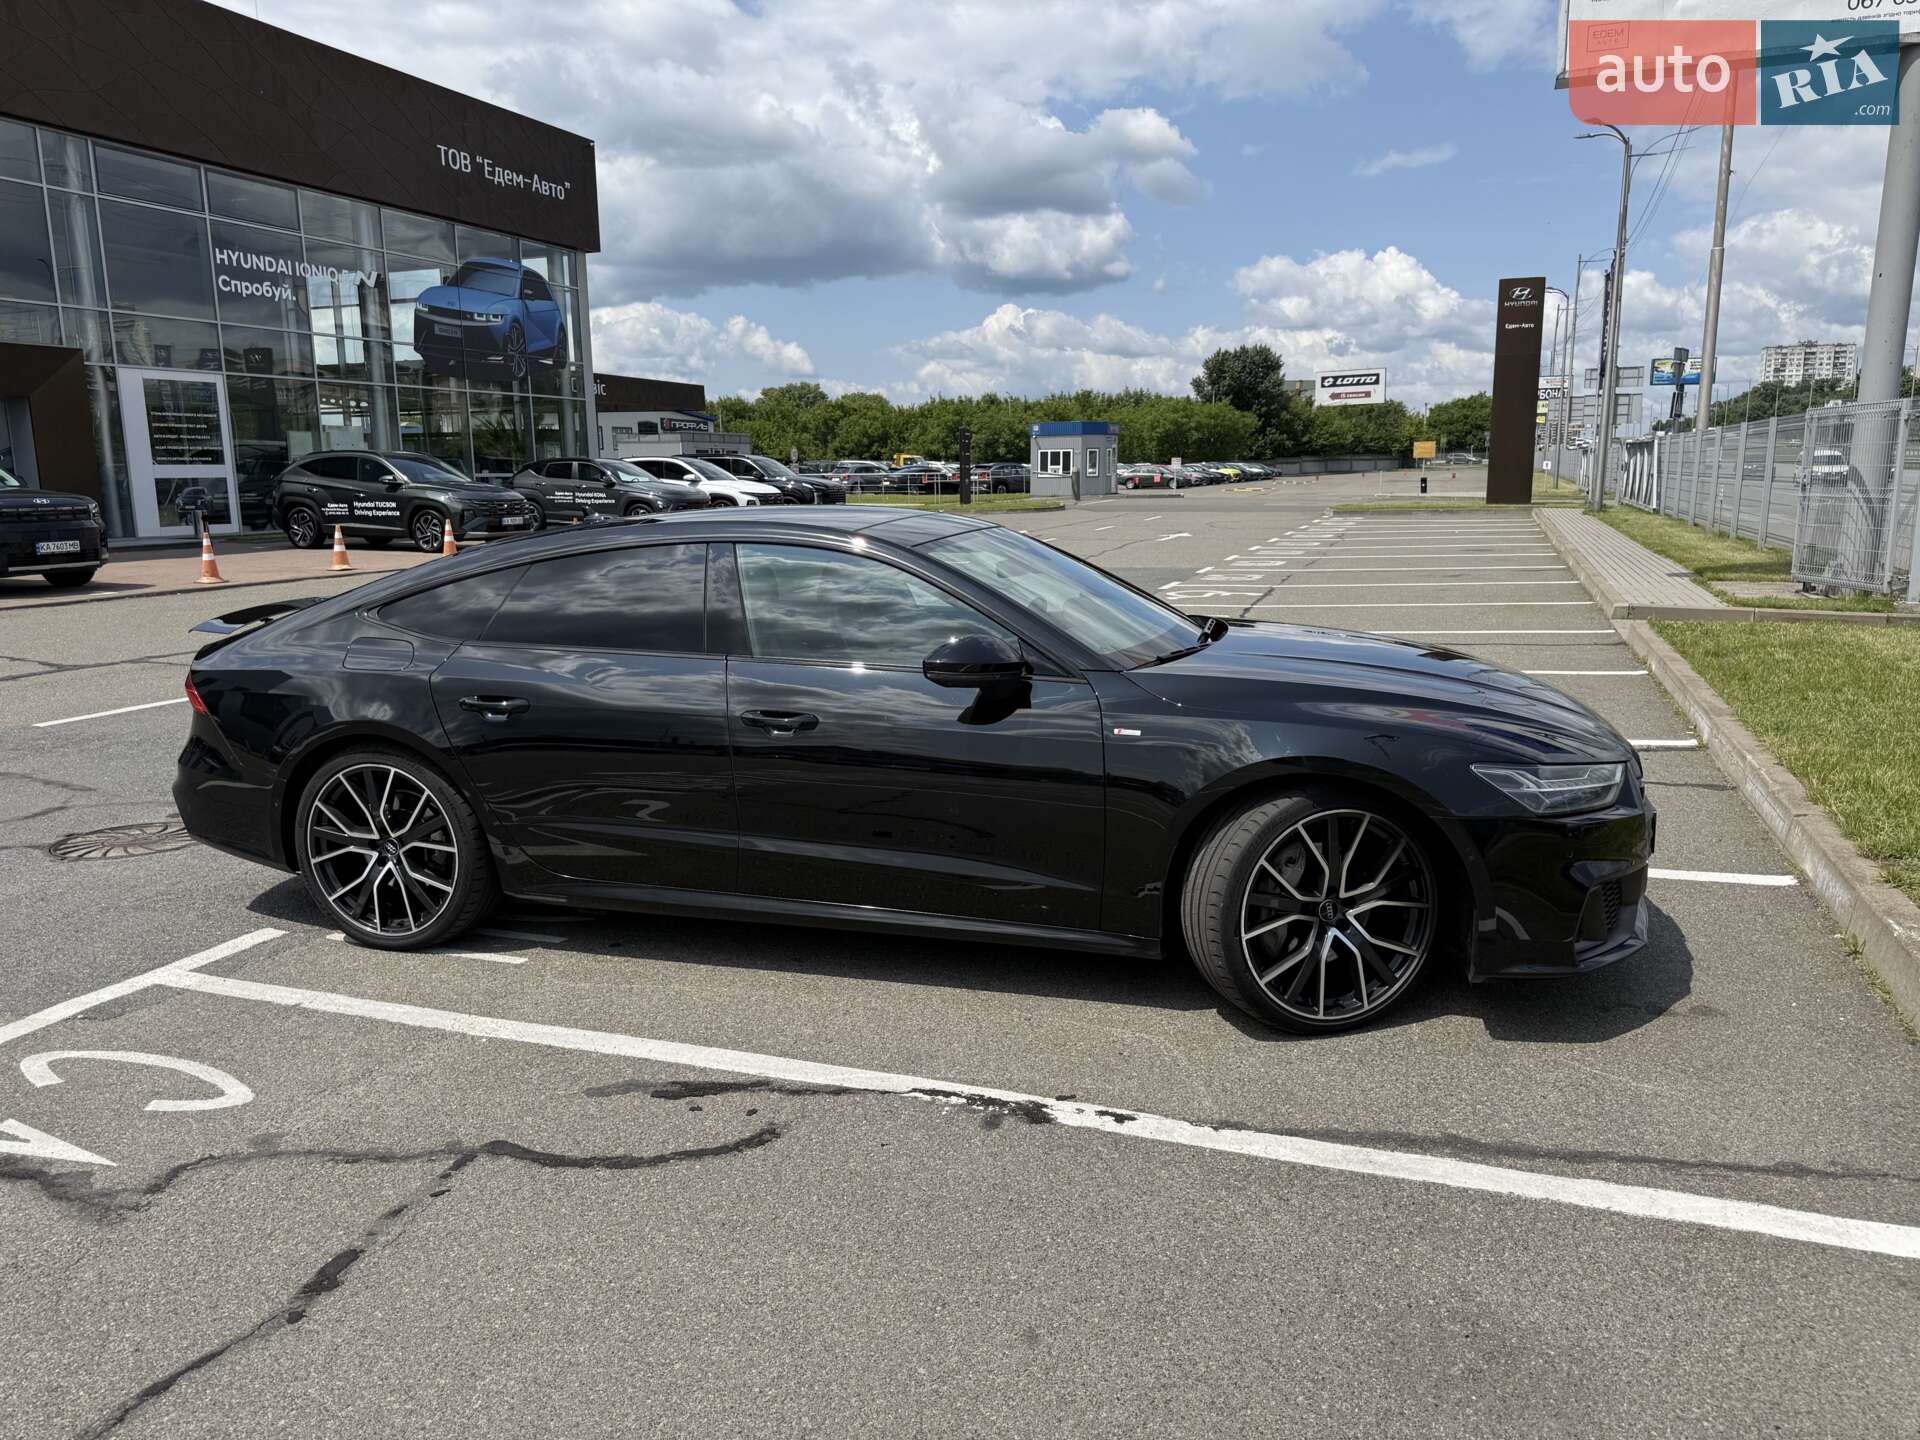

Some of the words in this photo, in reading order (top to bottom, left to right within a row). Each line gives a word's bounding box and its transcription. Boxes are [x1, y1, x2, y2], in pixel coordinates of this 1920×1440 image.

[436, 144, 471, 173] ТОВ
[215, 248, 292, 276] HYUNDAI
[295, 261, 338, 284] IONIQ
[218, 275, 296, 301] Спробуй.
[1336, 376, 1377, 385] LOTTO
